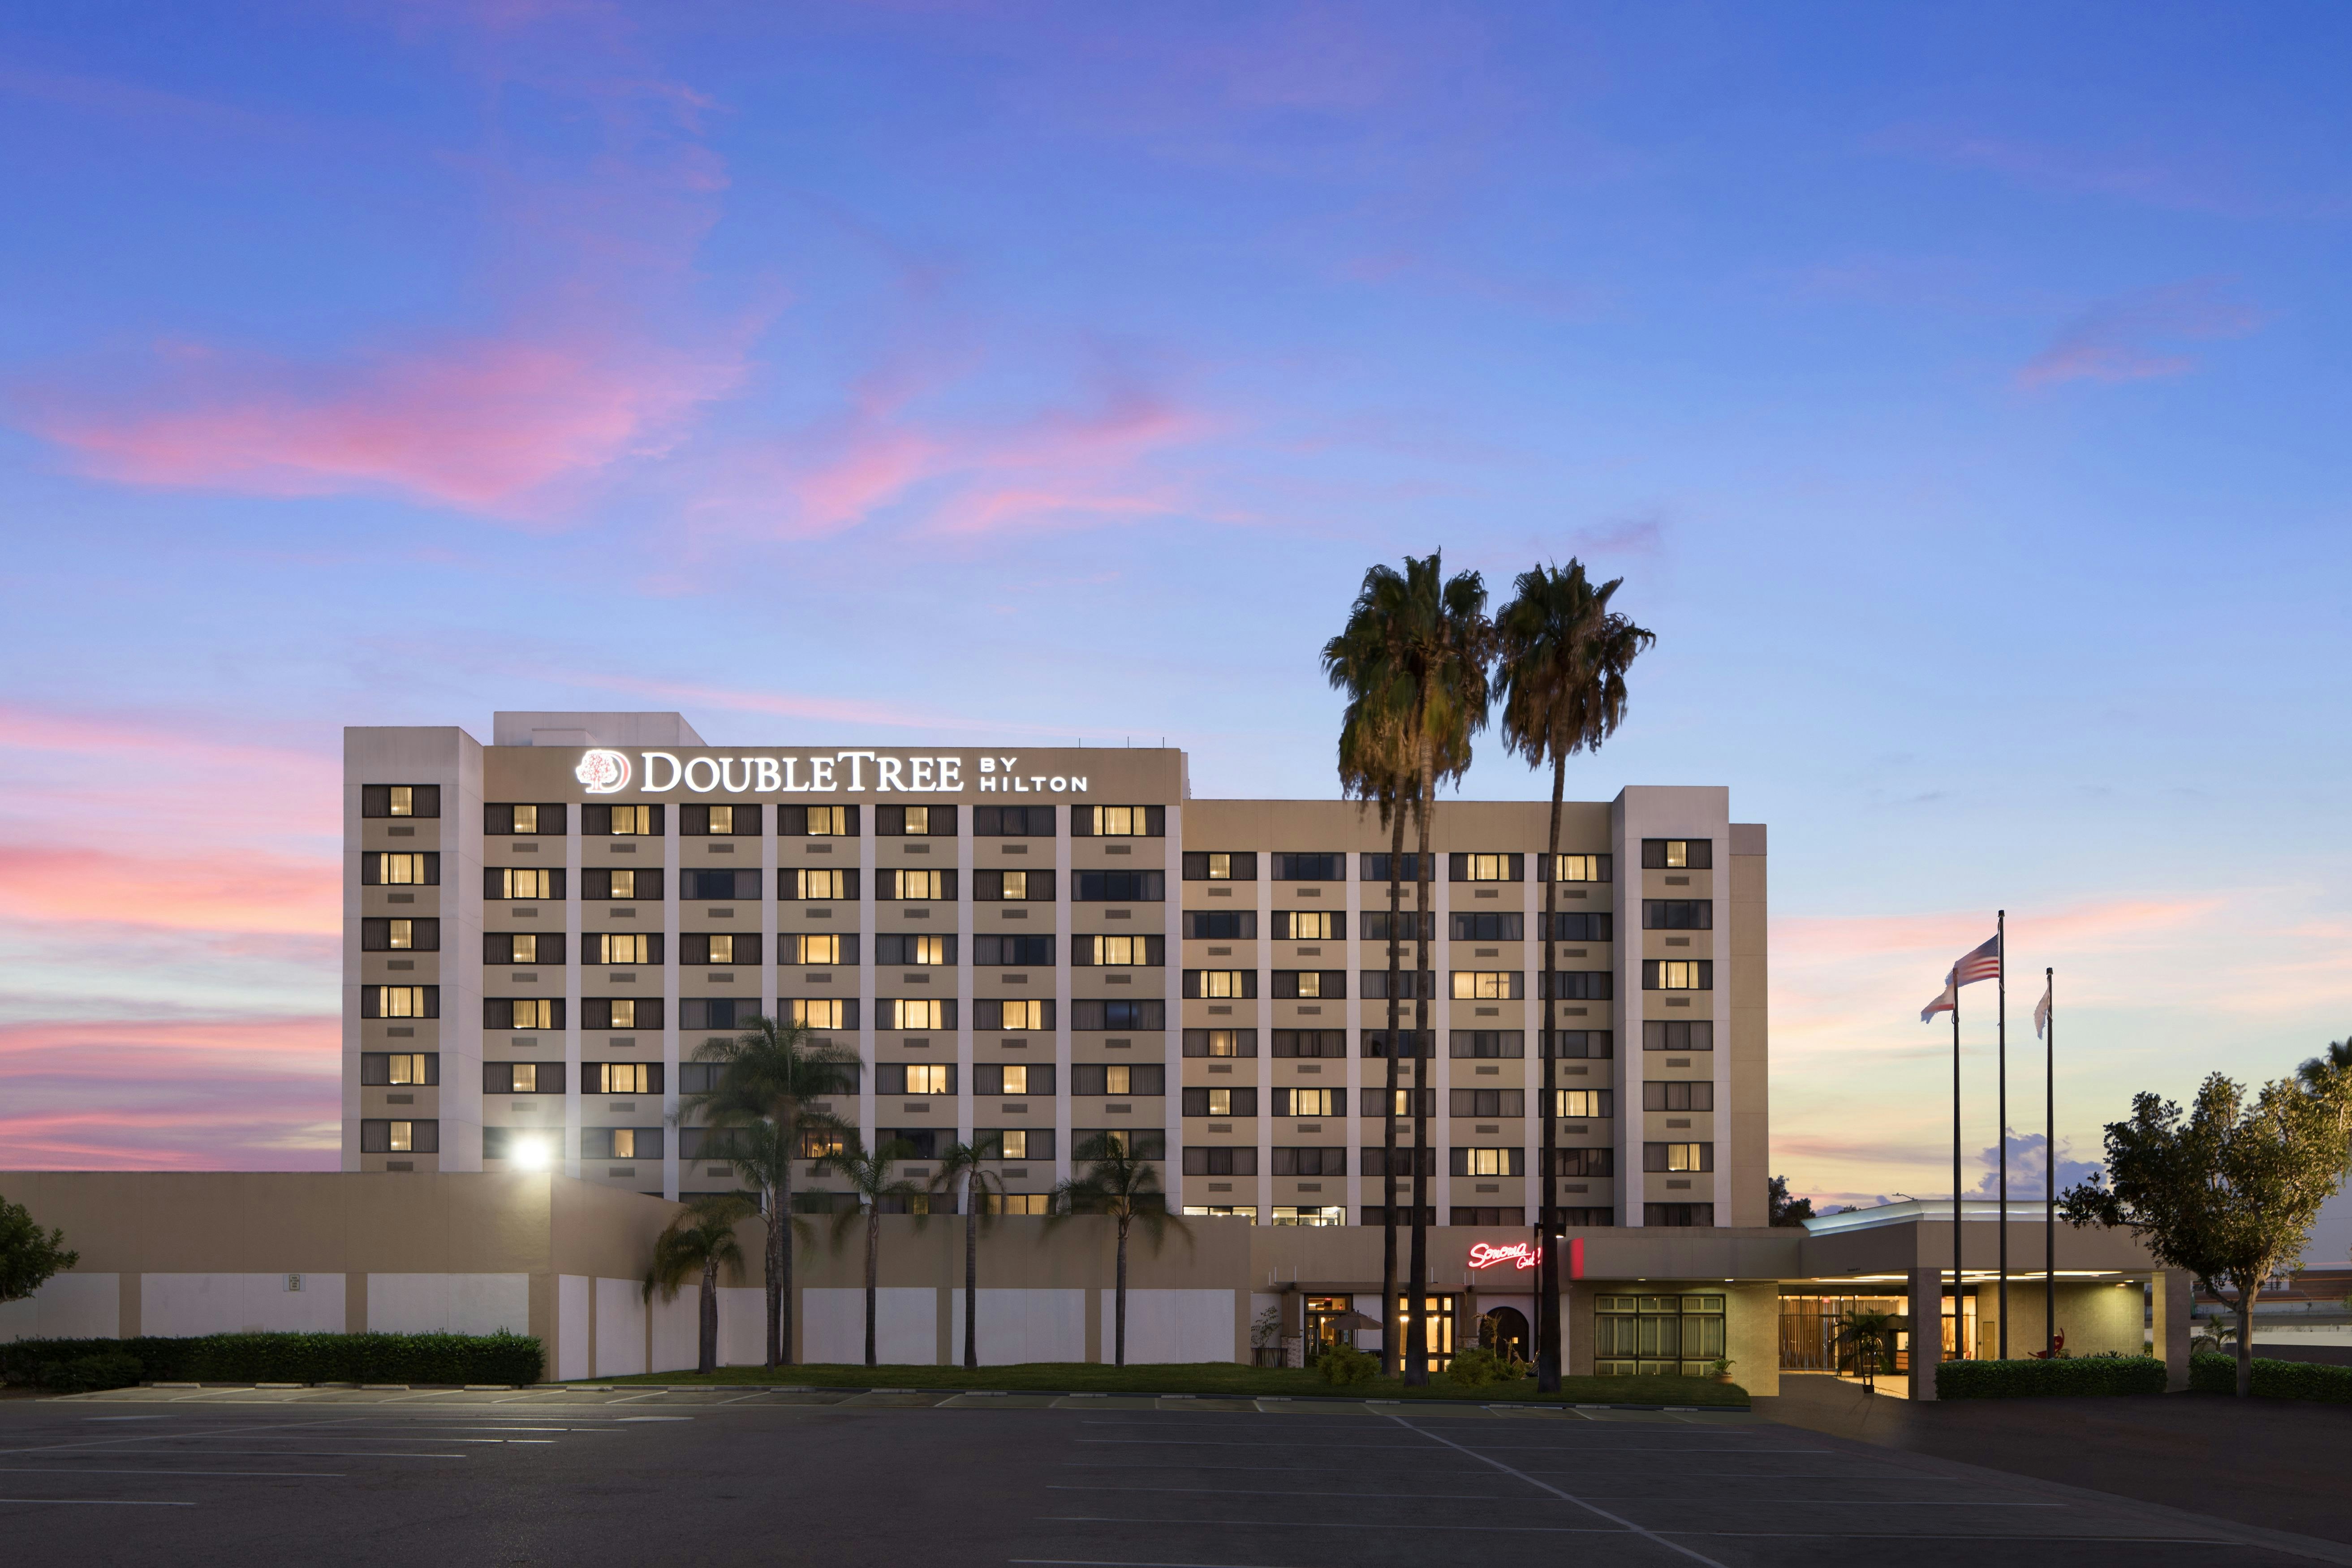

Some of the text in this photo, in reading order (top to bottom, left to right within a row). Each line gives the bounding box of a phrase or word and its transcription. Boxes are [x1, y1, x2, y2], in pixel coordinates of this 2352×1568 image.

[981, 758, 1017, 772] BY
[981, 777, 1087, 792] HILTON
[1469, 1243, 1527, 1267] Sonoma
